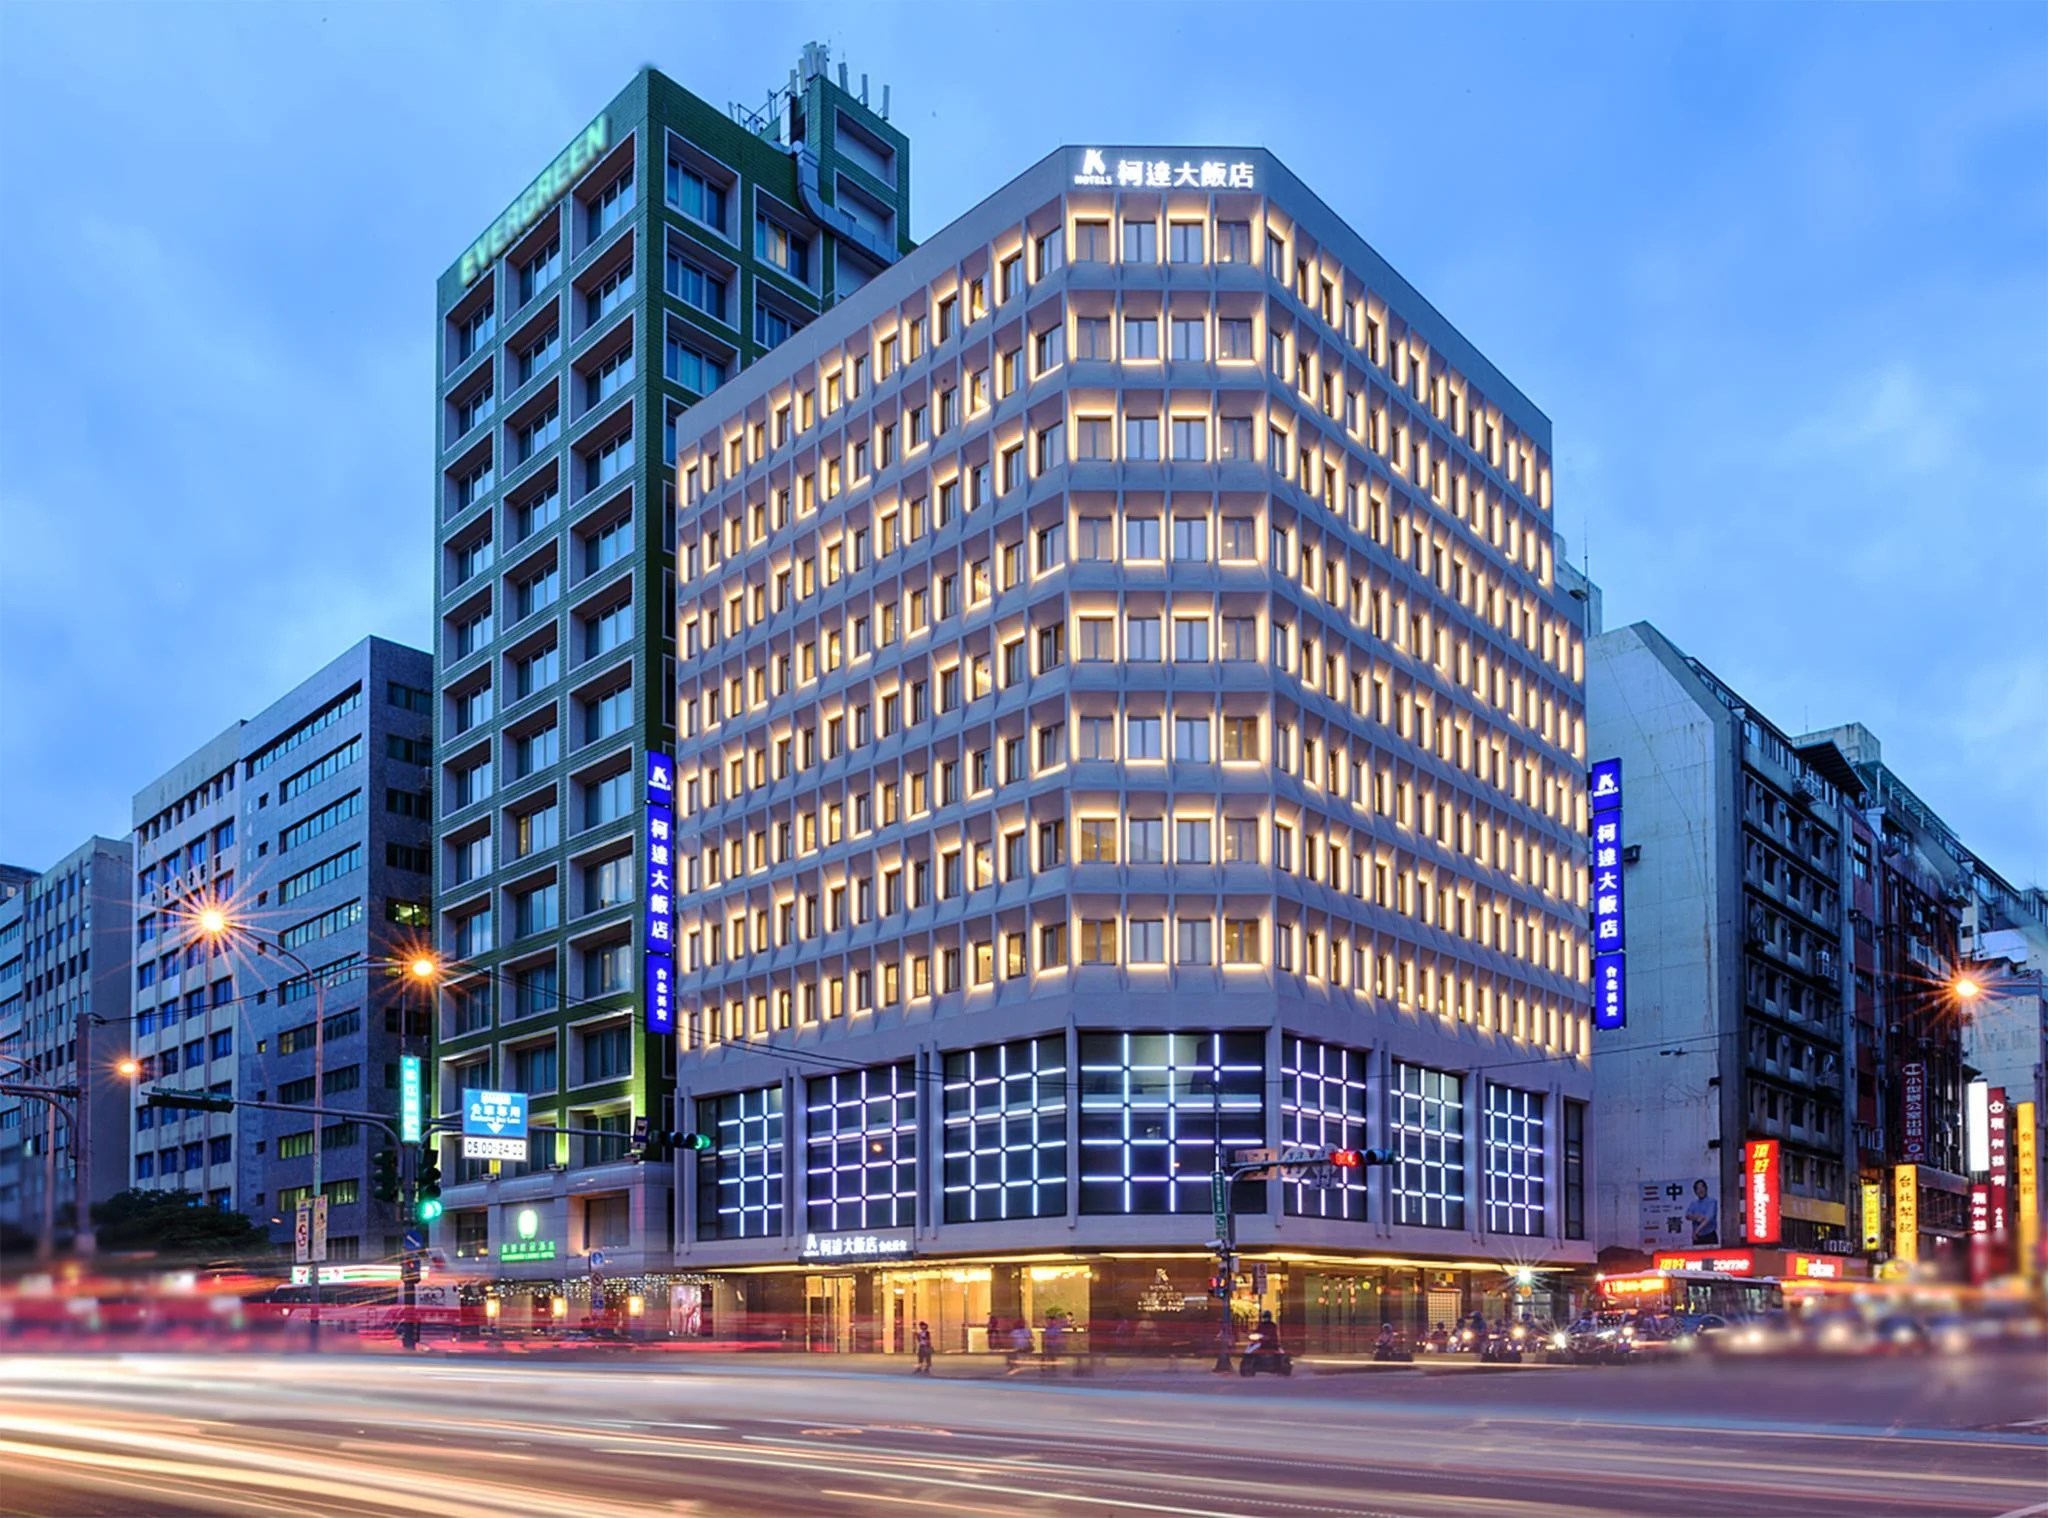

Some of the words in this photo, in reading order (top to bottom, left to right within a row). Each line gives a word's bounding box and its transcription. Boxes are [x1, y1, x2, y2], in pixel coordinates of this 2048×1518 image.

[1117, 159, 1255, 188] 柯達大飯店
[460, 112, 608, 287] EVERGREEN
[651, 818, 668, 940] 柯達大飯店
[1597, 823, 1618, 938] 柯達大飯店
[1753, 1144, 1770, 1173] 頂好
[820, 1236, 878, 1256] 柯達大飯店
[1686, 1259, 1750, 1272] wecome
